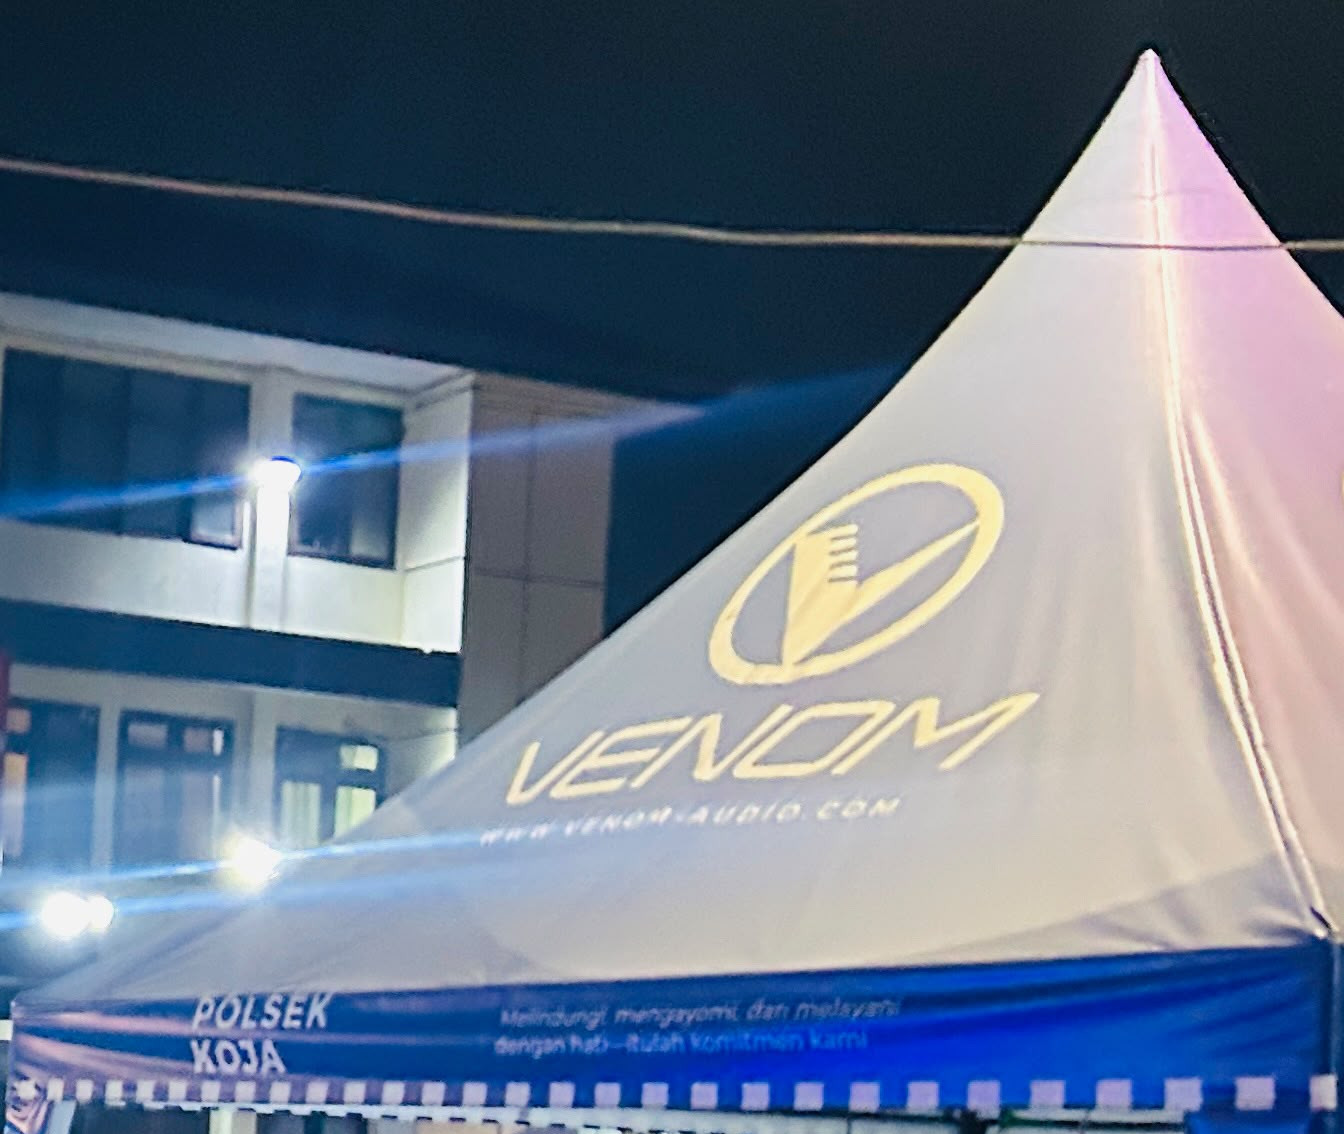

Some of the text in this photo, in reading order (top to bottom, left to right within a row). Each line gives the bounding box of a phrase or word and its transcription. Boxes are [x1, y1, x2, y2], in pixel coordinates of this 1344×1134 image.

[505, 693, 1041, 804] VENOM
[191, 992, 333, 1031] POLSEK
[746, 998, 791, 1020] dan
[190, 1038, 287, 1077] KOJA
